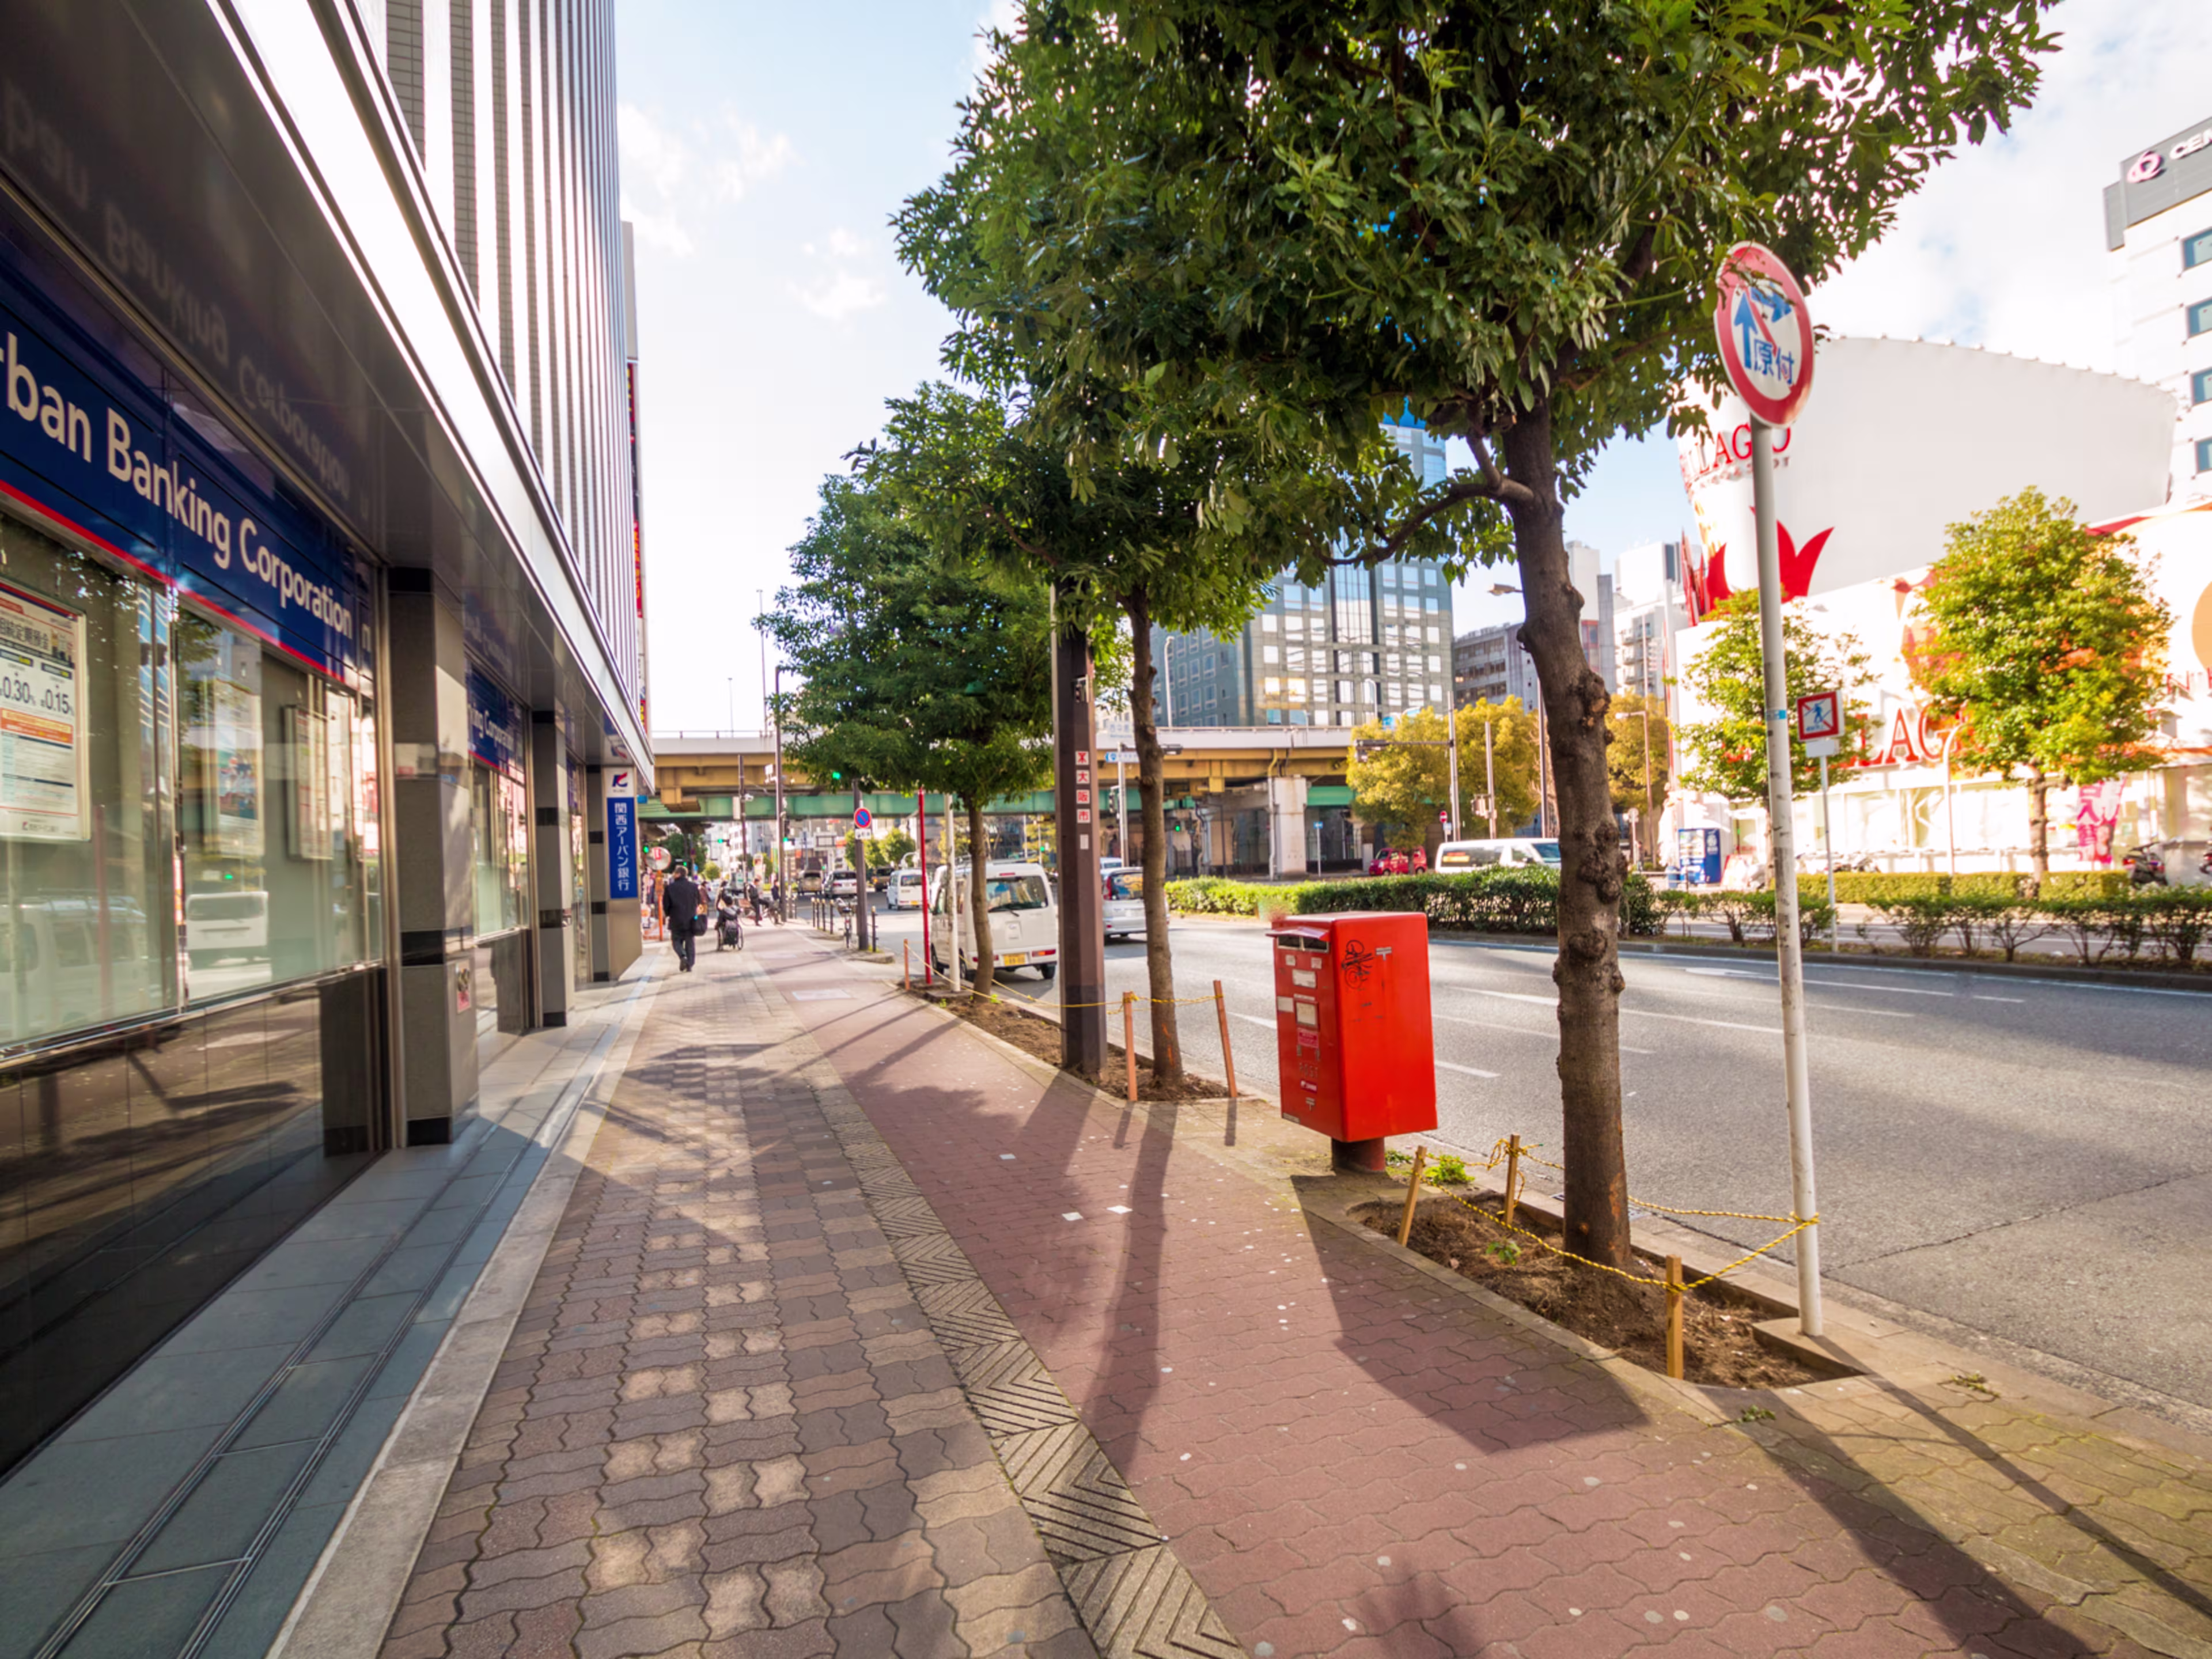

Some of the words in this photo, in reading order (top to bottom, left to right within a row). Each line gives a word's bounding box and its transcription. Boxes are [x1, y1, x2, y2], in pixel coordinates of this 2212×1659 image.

[1753, 339, 1795, 386] 原付
[0, 331, 91, 463] ban
[108, 407, 230, 569] Banking
[240, 518, 353, 639] Corporation
[1077, 771, 1089, 821] 大阪市
[614, 802, 630, 891] 関西アーバン銀行
